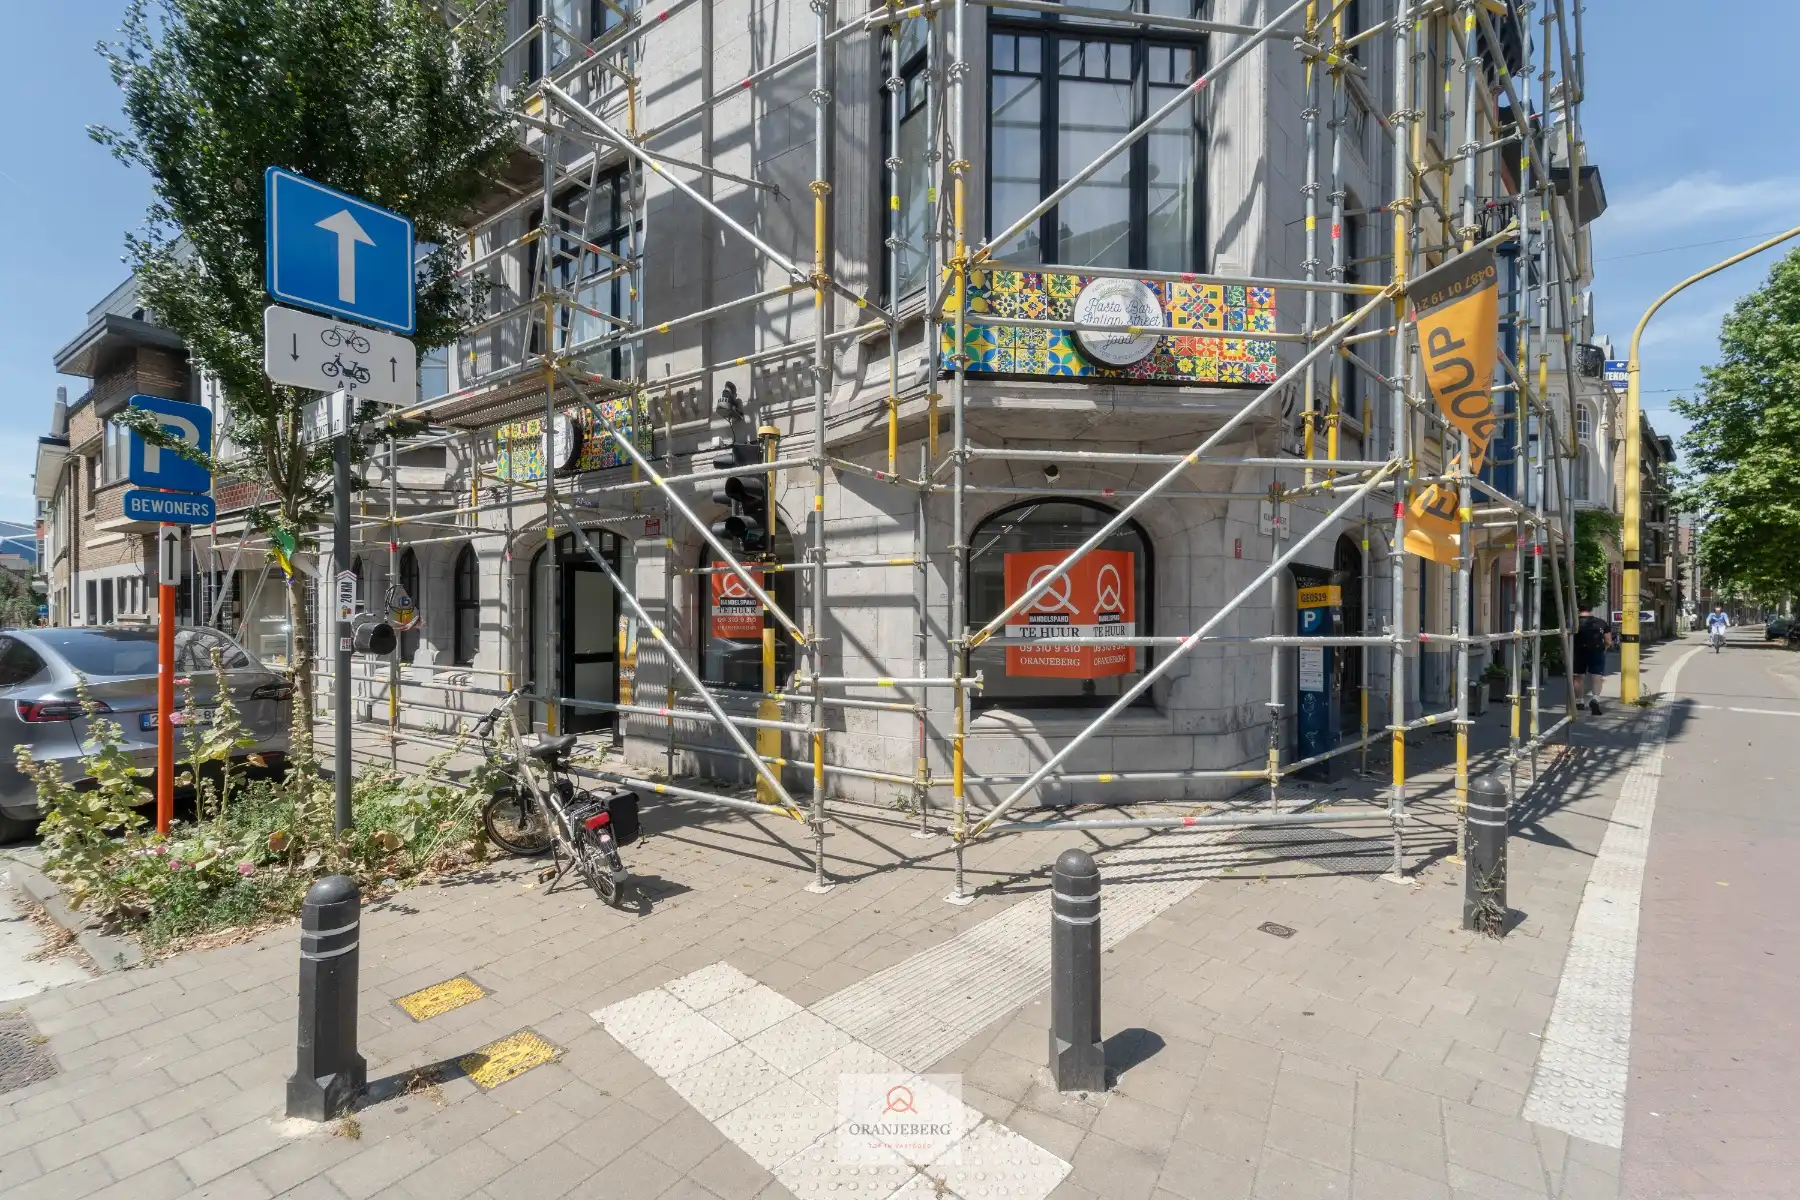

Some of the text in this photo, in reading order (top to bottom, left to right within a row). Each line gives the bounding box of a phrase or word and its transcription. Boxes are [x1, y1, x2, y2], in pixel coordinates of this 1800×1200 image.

[1416, 265, 1495, 312] 0487 01 19 21
[1084, 298, 1153, 317] Pasta Bar
[1102, 332, 1134, 350] food
[350, 383, 357, 391] P
[131, 498, 209, 517] BEWONERS
[340, 582, 352, 603] 20 KM
[1304, 611, 1316, 628] P
[1020, 627, 1080, 637] TE HUUR
[1093, 625, 1126, 637] TE HUUR
[1020, 657, 1080, 666] ORANJEBERG
